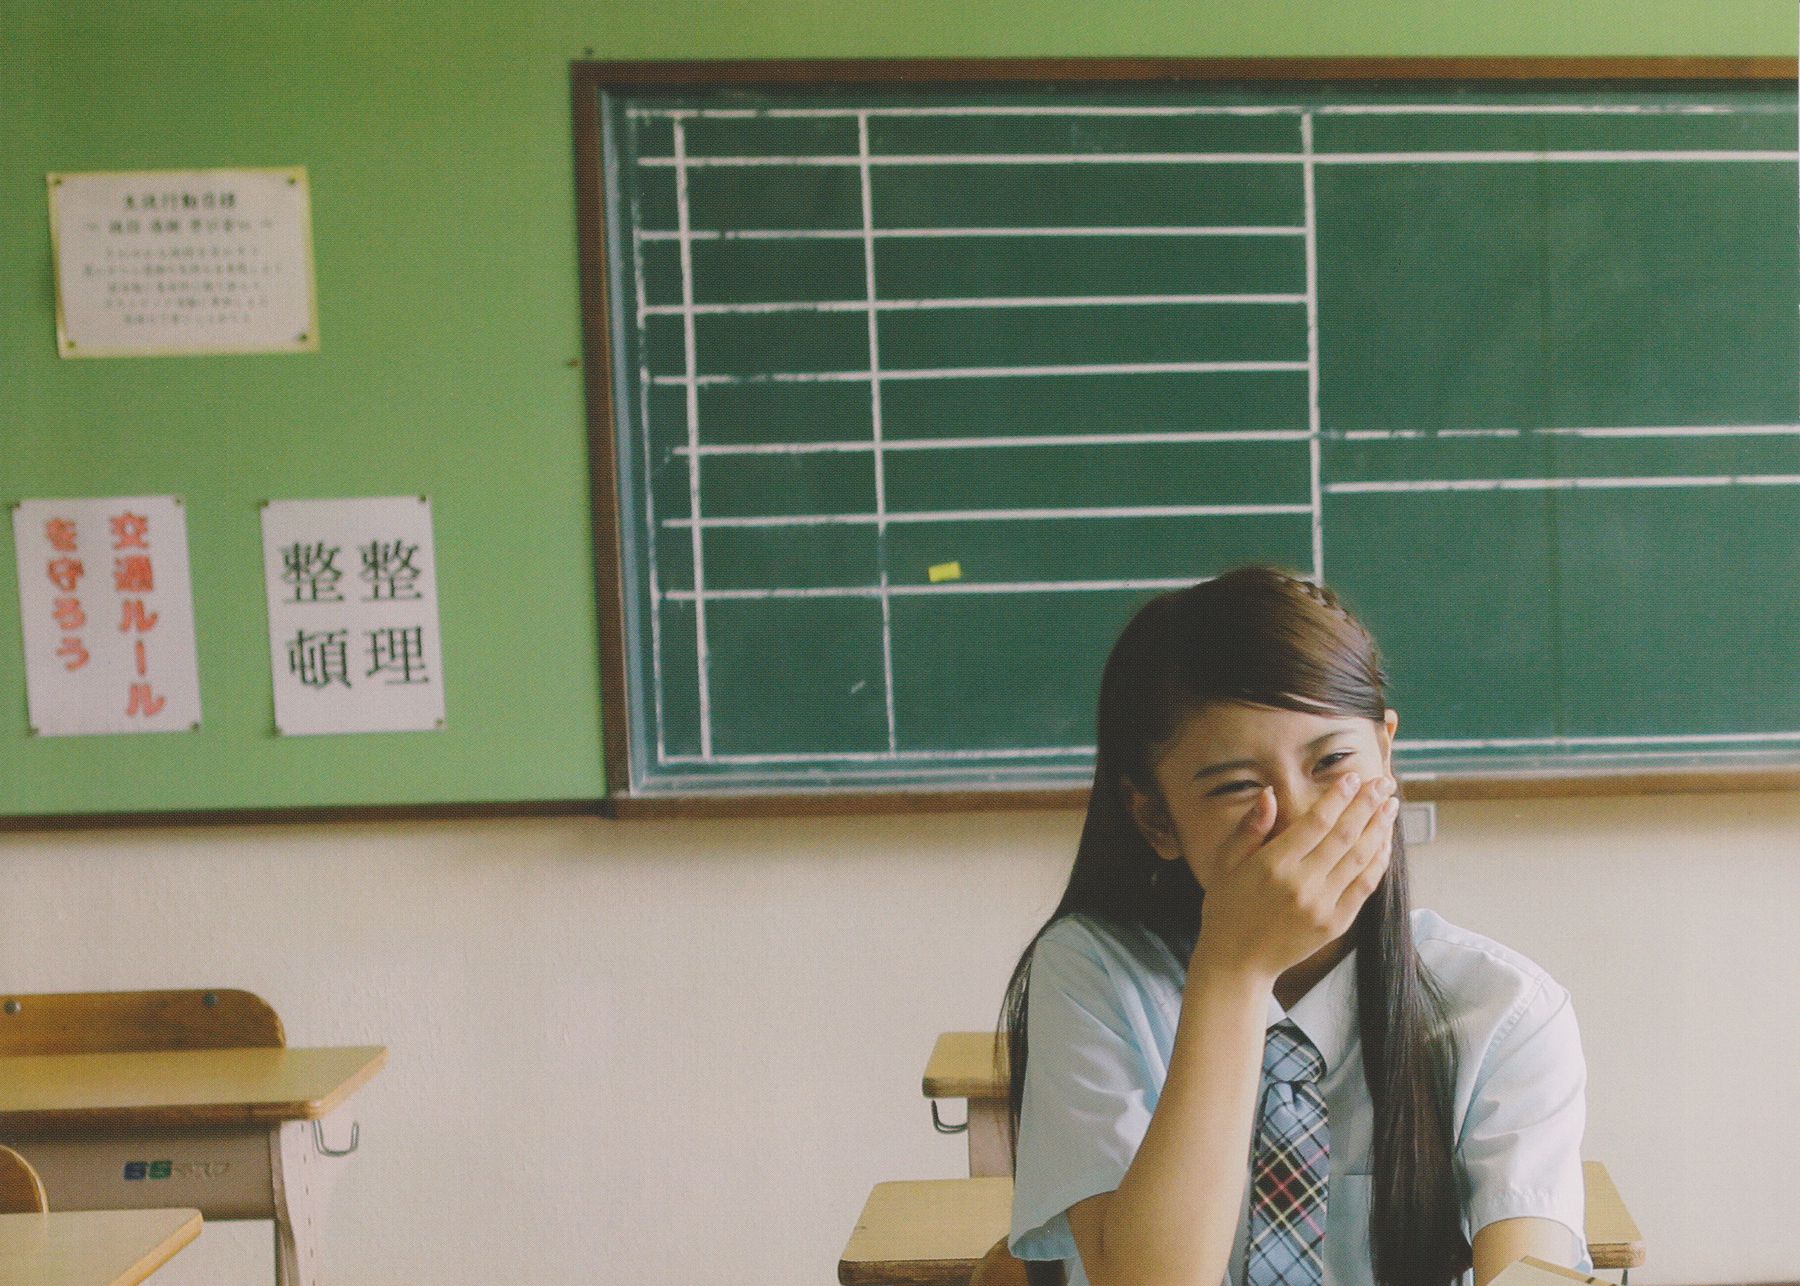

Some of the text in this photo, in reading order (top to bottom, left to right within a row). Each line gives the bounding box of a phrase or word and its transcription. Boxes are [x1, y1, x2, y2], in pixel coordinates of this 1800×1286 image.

[110, 512, 167, 717] 交通ルール
[279, 541, 352, 690] 整頓
[356, 539, 430, 686] 整理
